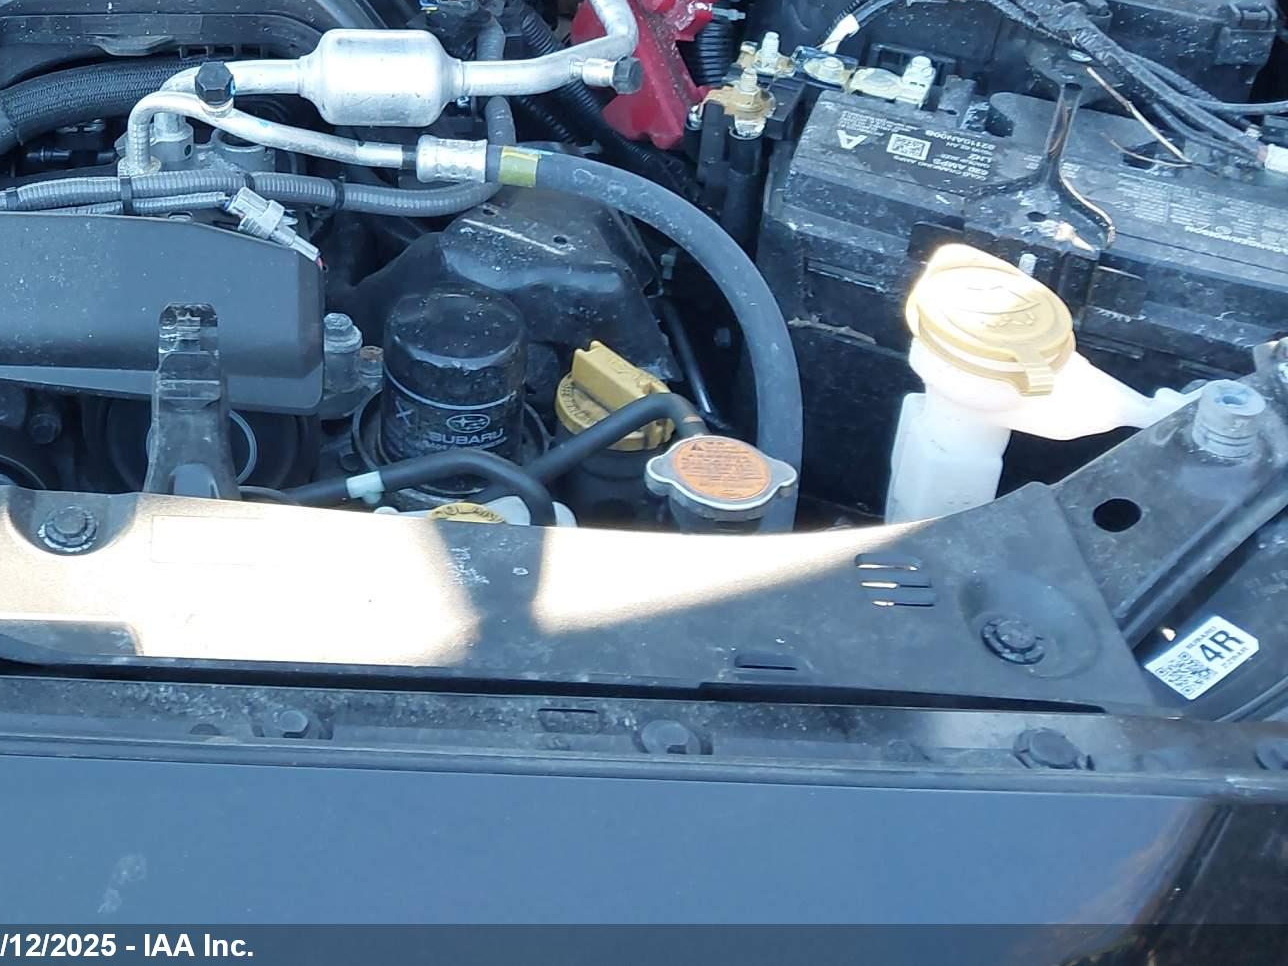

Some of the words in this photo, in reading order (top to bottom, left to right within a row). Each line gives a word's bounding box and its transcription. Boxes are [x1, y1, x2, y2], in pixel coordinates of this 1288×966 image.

[932, 159, 966, 169] AMPS
[425, 427, 504, 444] SUBARU
[1199, 630, 1245, 663] 4R
